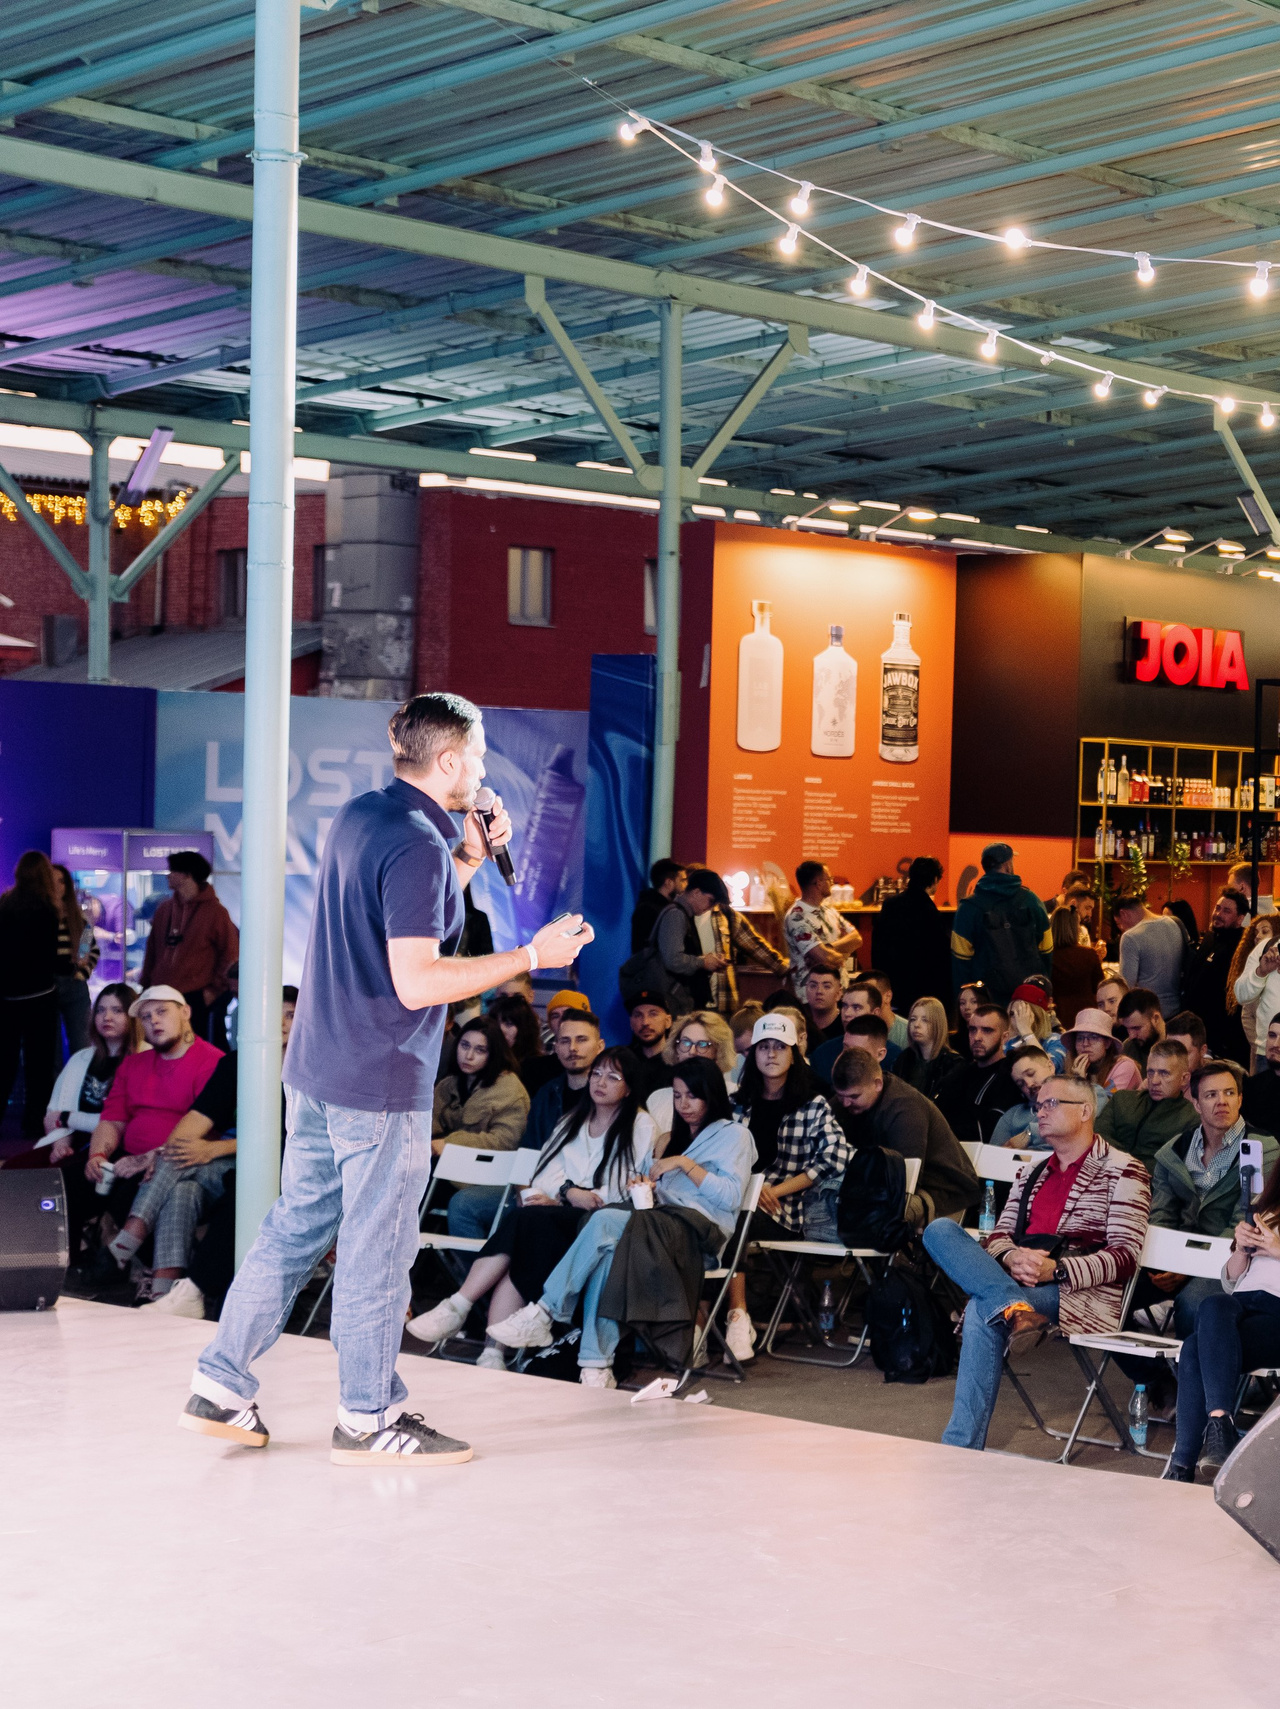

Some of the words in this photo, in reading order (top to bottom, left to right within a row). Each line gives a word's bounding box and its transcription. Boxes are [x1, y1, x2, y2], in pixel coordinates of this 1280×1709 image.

[883, 672, 919, 691] JAWBOX
[1135, 620, 1250, 691] JOIA
[204, 741, 396, 807] LST
